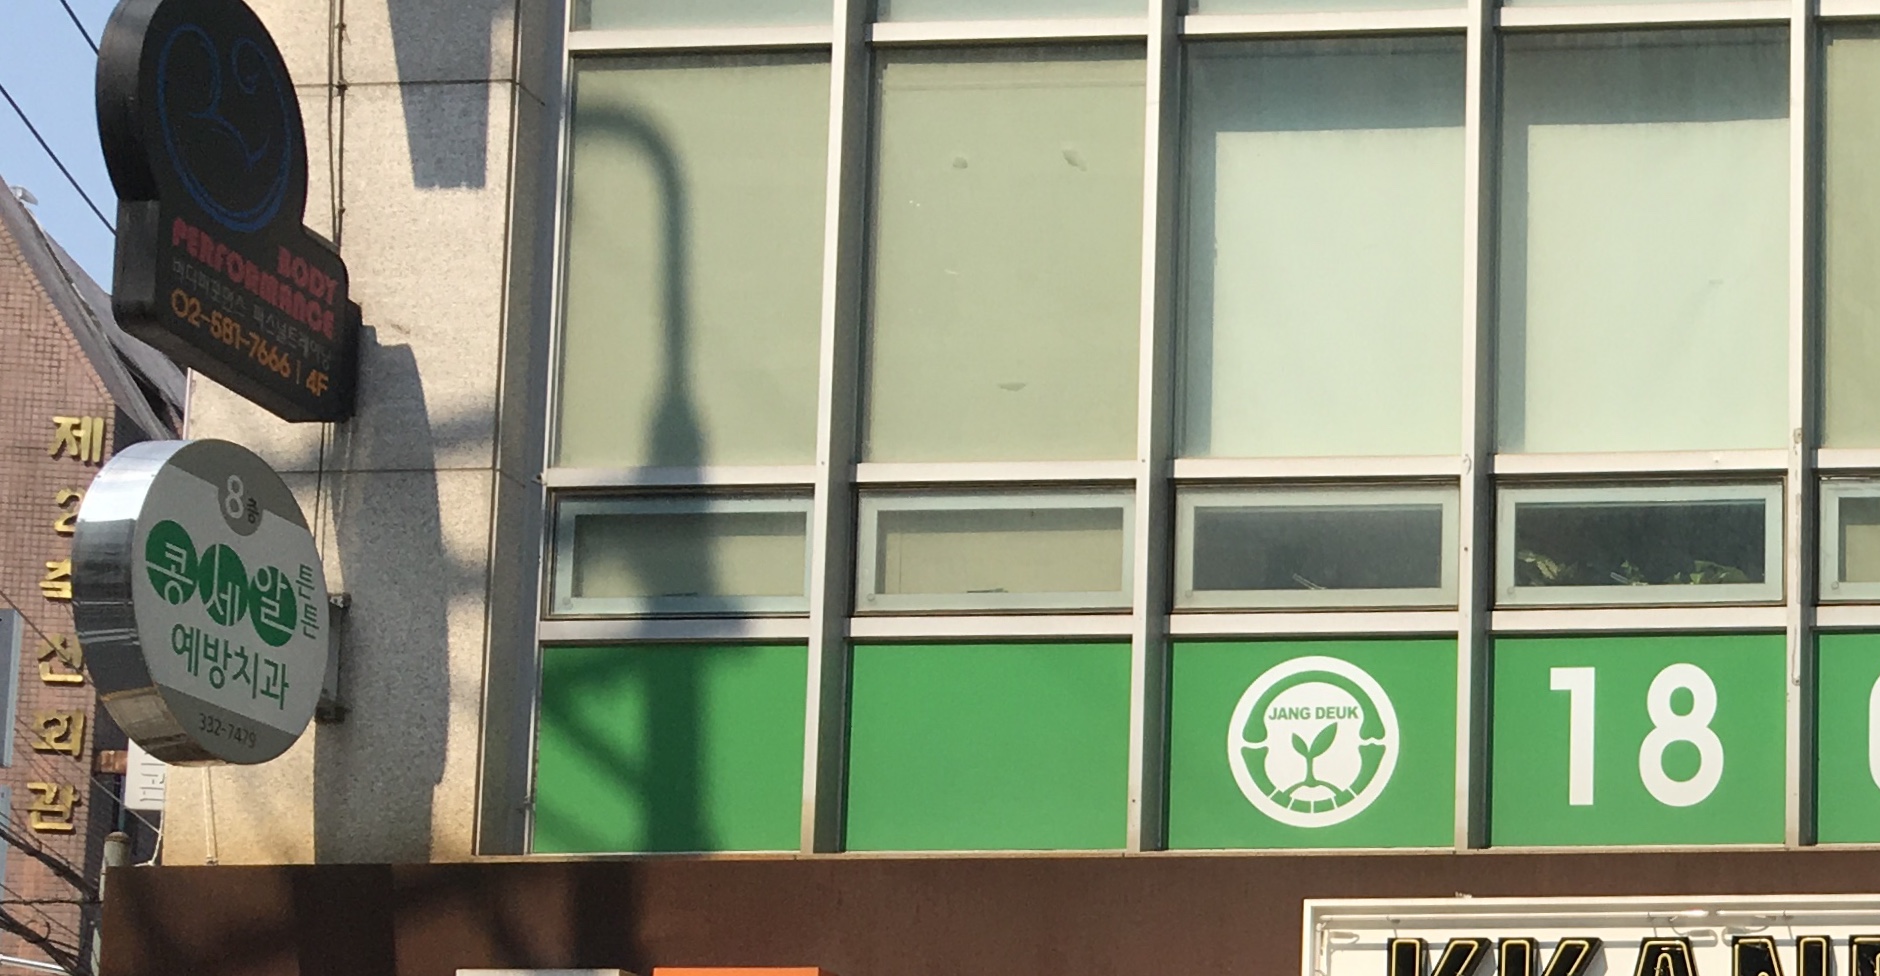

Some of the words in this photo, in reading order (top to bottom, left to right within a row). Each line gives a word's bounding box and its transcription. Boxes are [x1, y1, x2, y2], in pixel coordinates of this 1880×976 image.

[171, 217, 335, 340] PERFORMANCE
[277, 245, 338, 306] BODY
[305, 368, 330, 398] 4F
[146, 540, 297, 636] 콩세알
[171, 623, 290, 711] 예방치과
[1268, 707, 1311, 720] JANG
[1315, 706, 1359, 719] DEUK
[1550, 662, 1725, 807] 18
